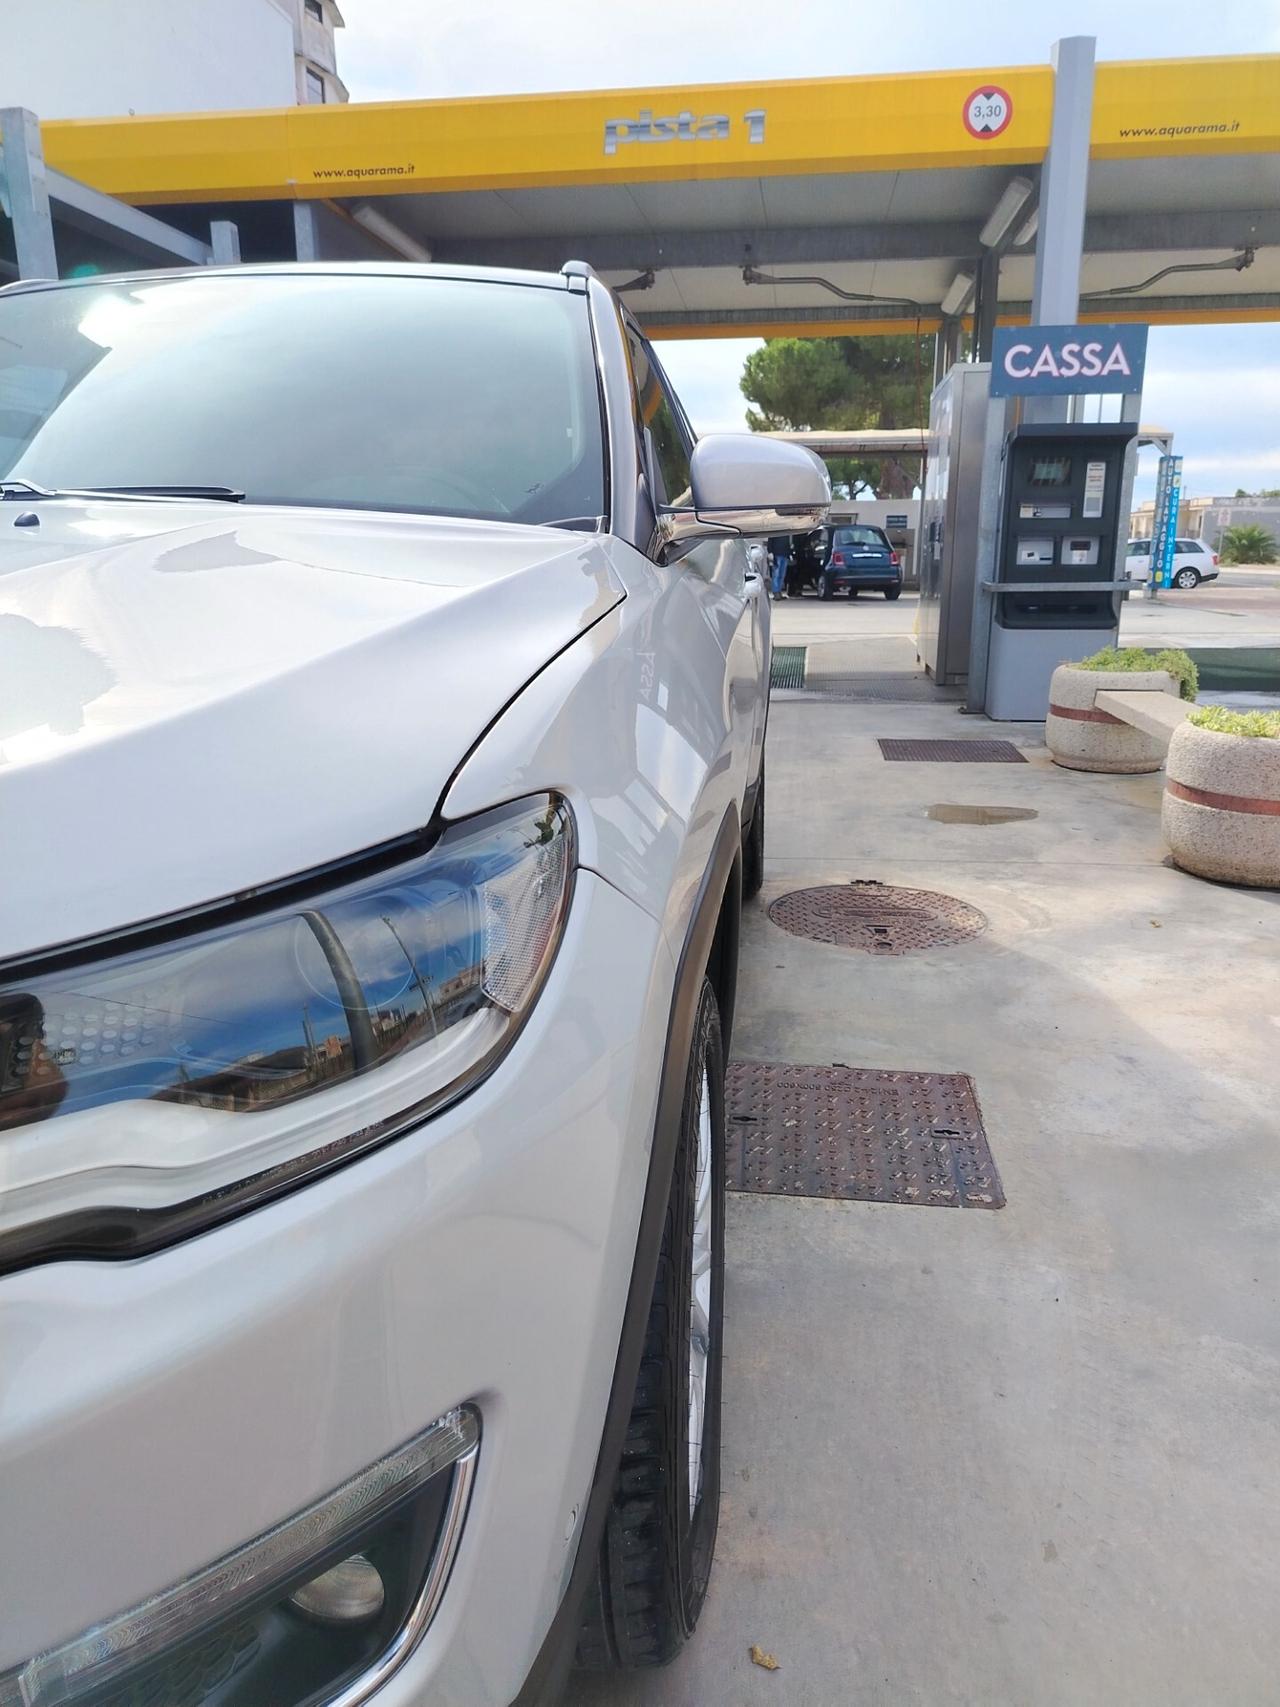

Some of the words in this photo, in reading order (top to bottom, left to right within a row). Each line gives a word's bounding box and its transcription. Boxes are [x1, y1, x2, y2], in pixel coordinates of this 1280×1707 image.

[973, 104, 1002, 120] 3,30
[603, 110, 730, 154] pista
[743, 109, 767, 144] 1
[1119, 120, 1240, 138] www.aquarama.it
[313, 163, 415, 179] www.aquarama.it
[1003, 342, 1131, 379] CASSA
